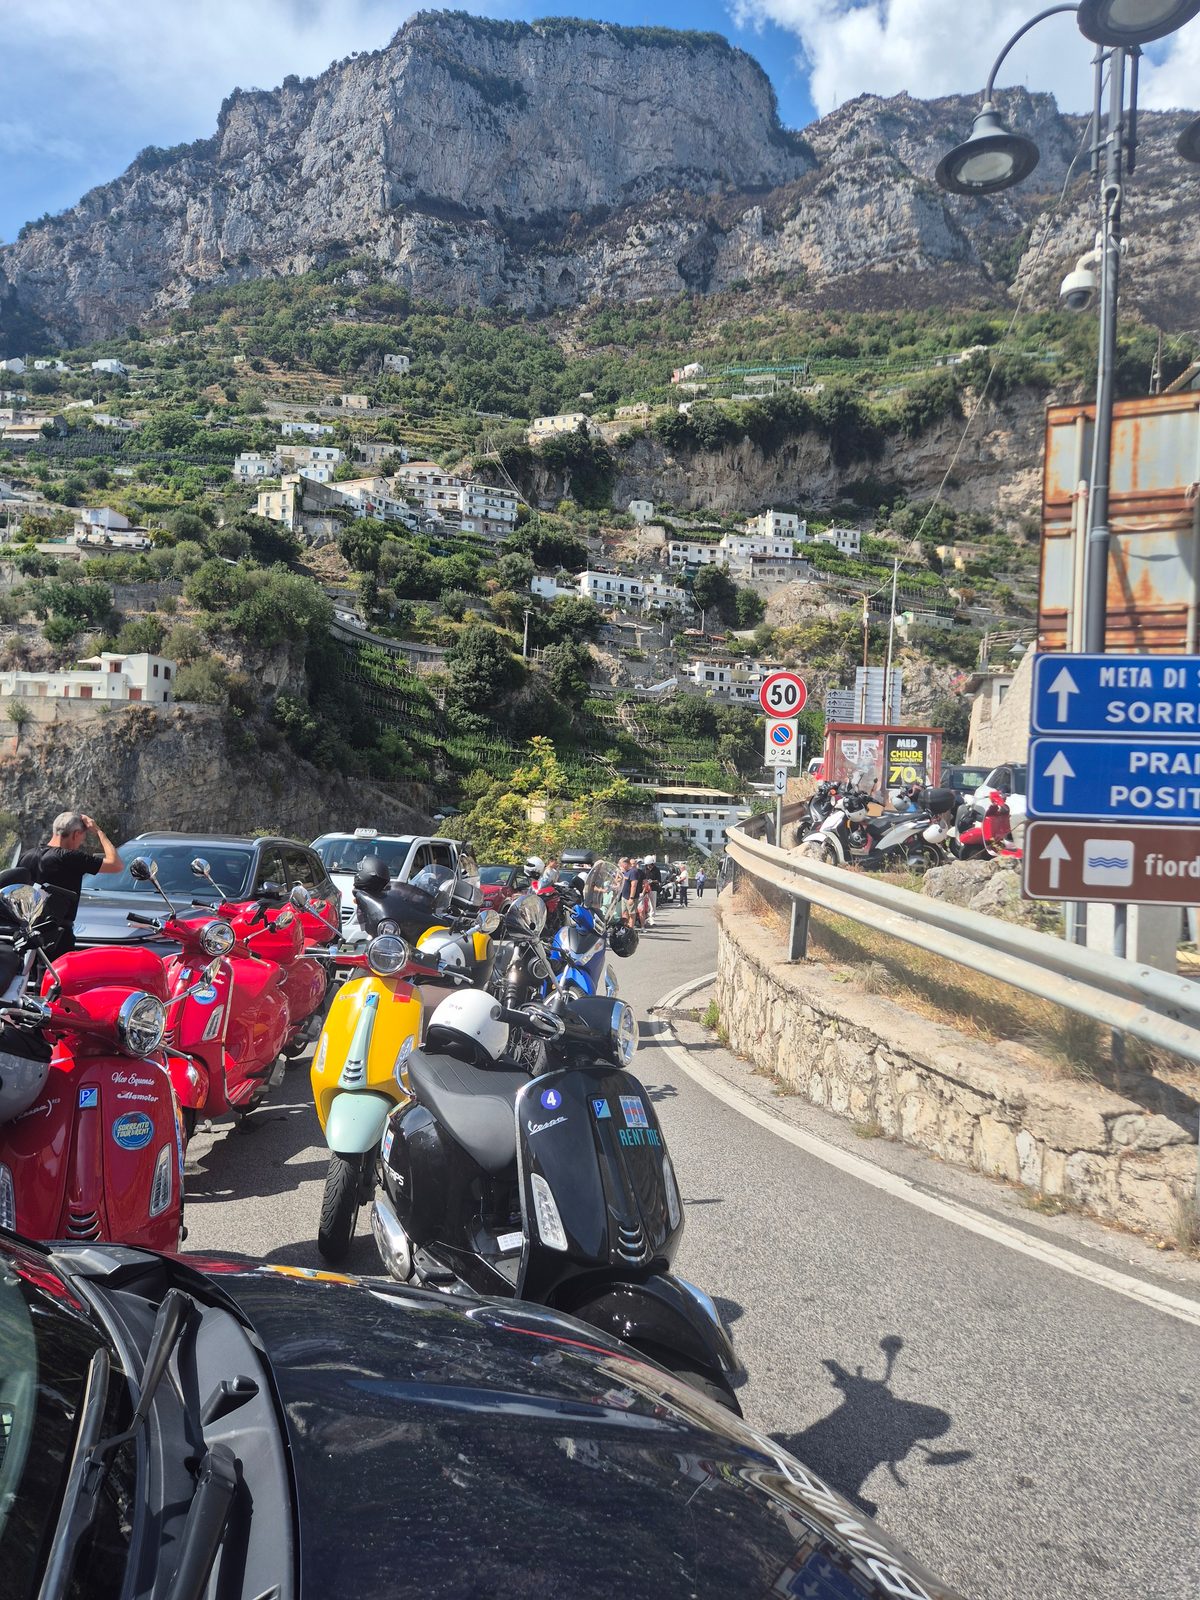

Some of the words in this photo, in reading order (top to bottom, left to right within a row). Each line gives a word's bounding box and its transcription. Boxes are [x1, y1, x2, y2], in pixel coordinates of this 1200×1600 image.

[1100, 666, 1152, 688] META
[1163, 667, 1186, 689] DI
[771, 684, 797, 706] 50
[896, 738, 917, 748] MED
[890, 750, 923, 759] CHIUDE
[1144, 853, 1200, 879] fiord
[547, 1091, 557, 1106] 4
[527, 1115, 568, 1136] Vespa
[619, 1129, 645, 1146] RENT
[646, 1129, 661, 1146] ME
